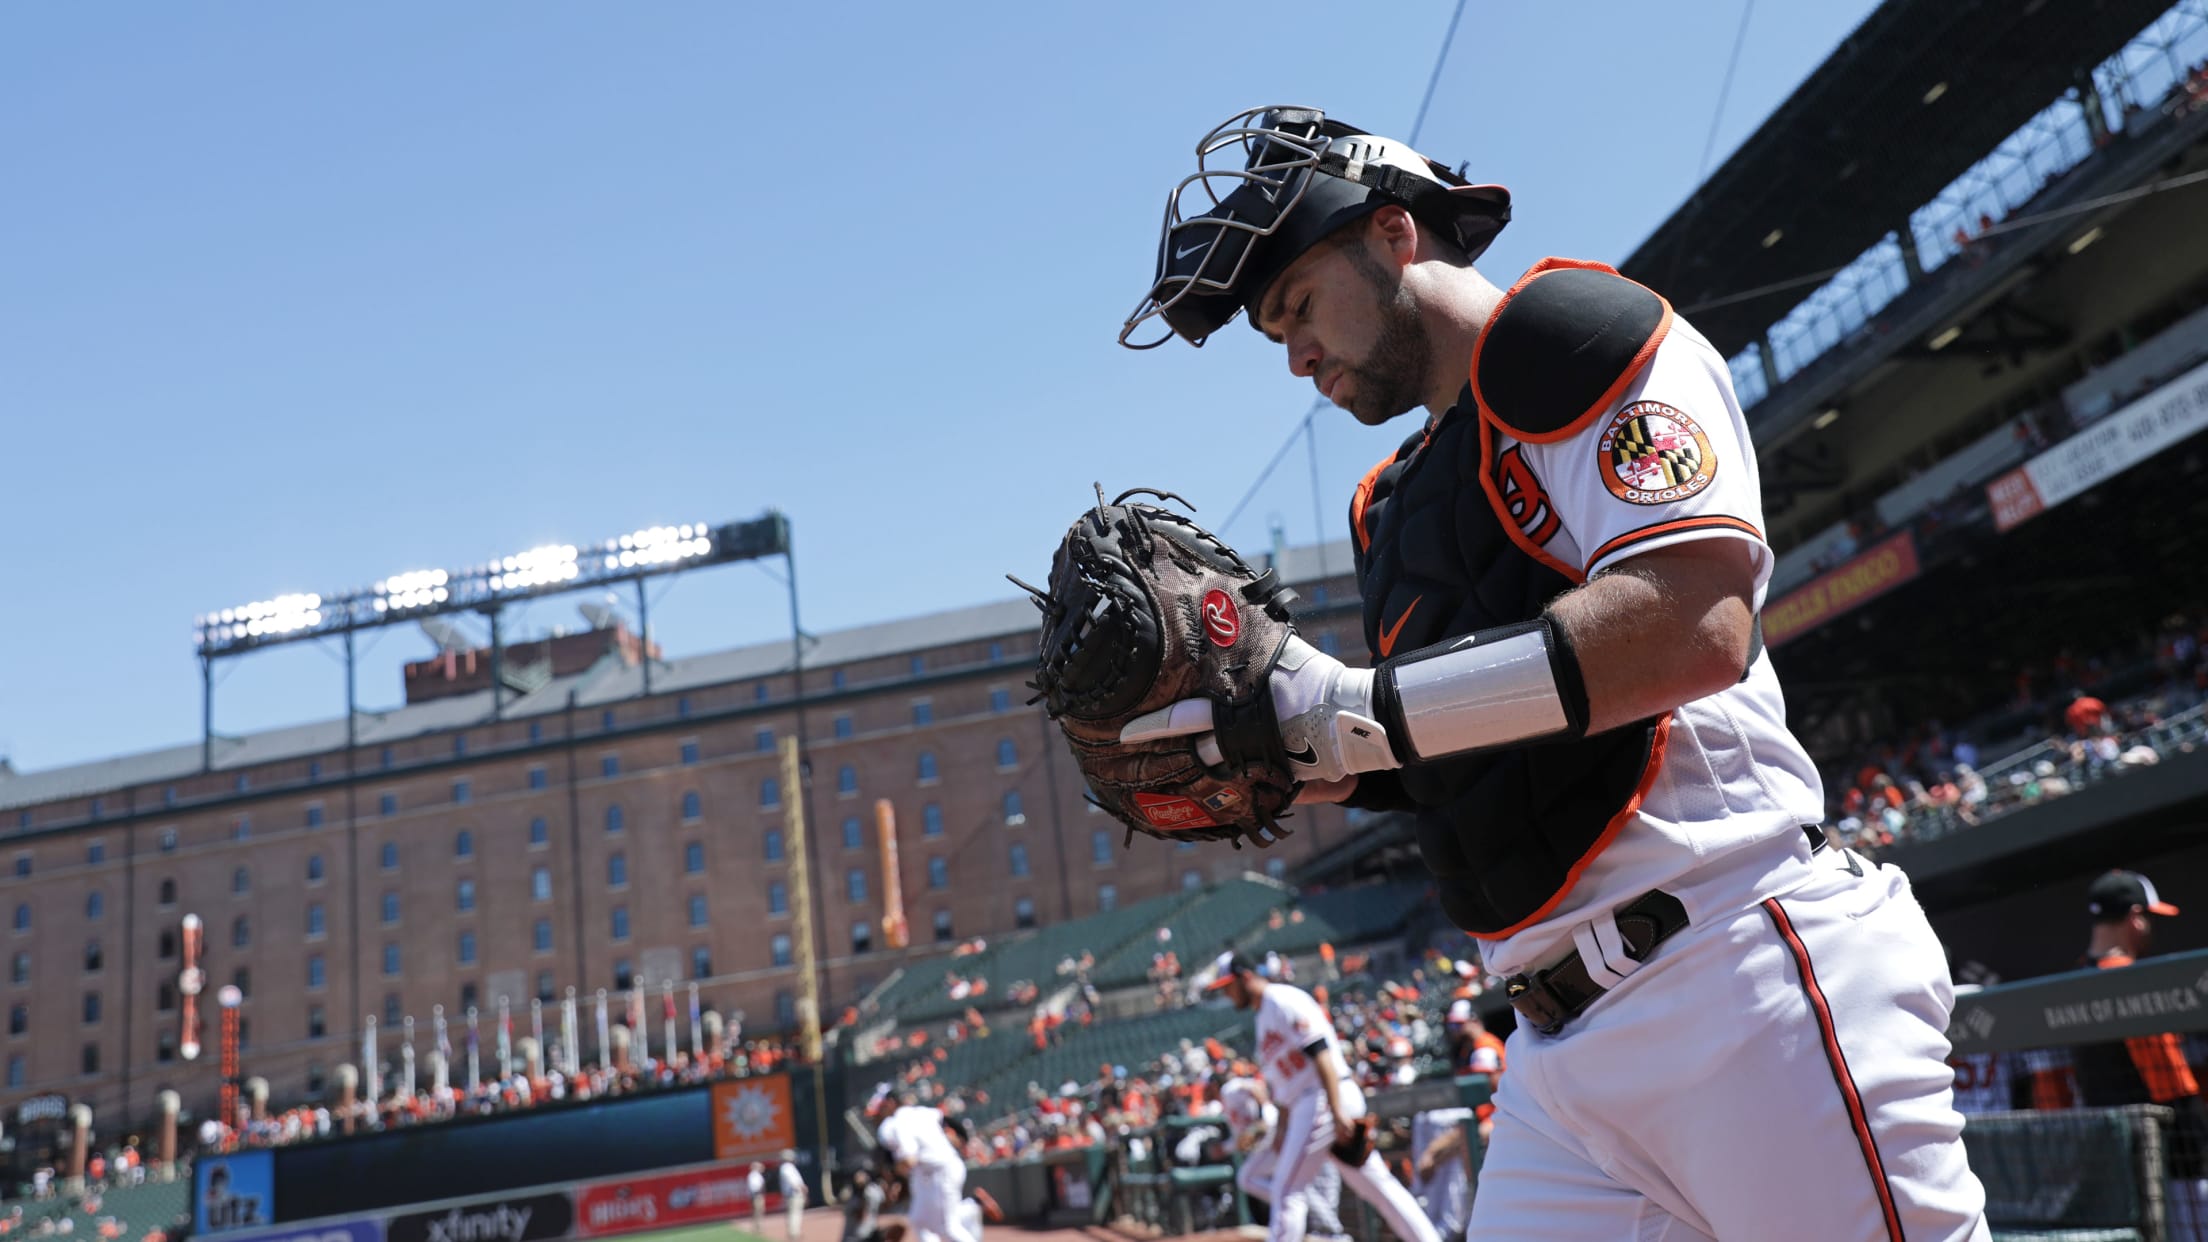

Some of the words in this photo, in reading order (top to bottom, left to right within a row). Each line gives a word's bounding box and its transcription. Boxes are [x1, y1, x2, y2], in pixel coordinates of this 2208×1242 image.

[1601, 403, 1701, 452] BALTIMORE
[1625, 474, 1708, 502] ORIOLES
[1351, 727, 1371, 739] NIKE
[2044, 1004, 2089, 1028] BANK
[2090, 998, 2114, 1022] OF
[2115, 987, 2198, 1017] AMERICA
[426, 1203, 533, 1242] xfinity
